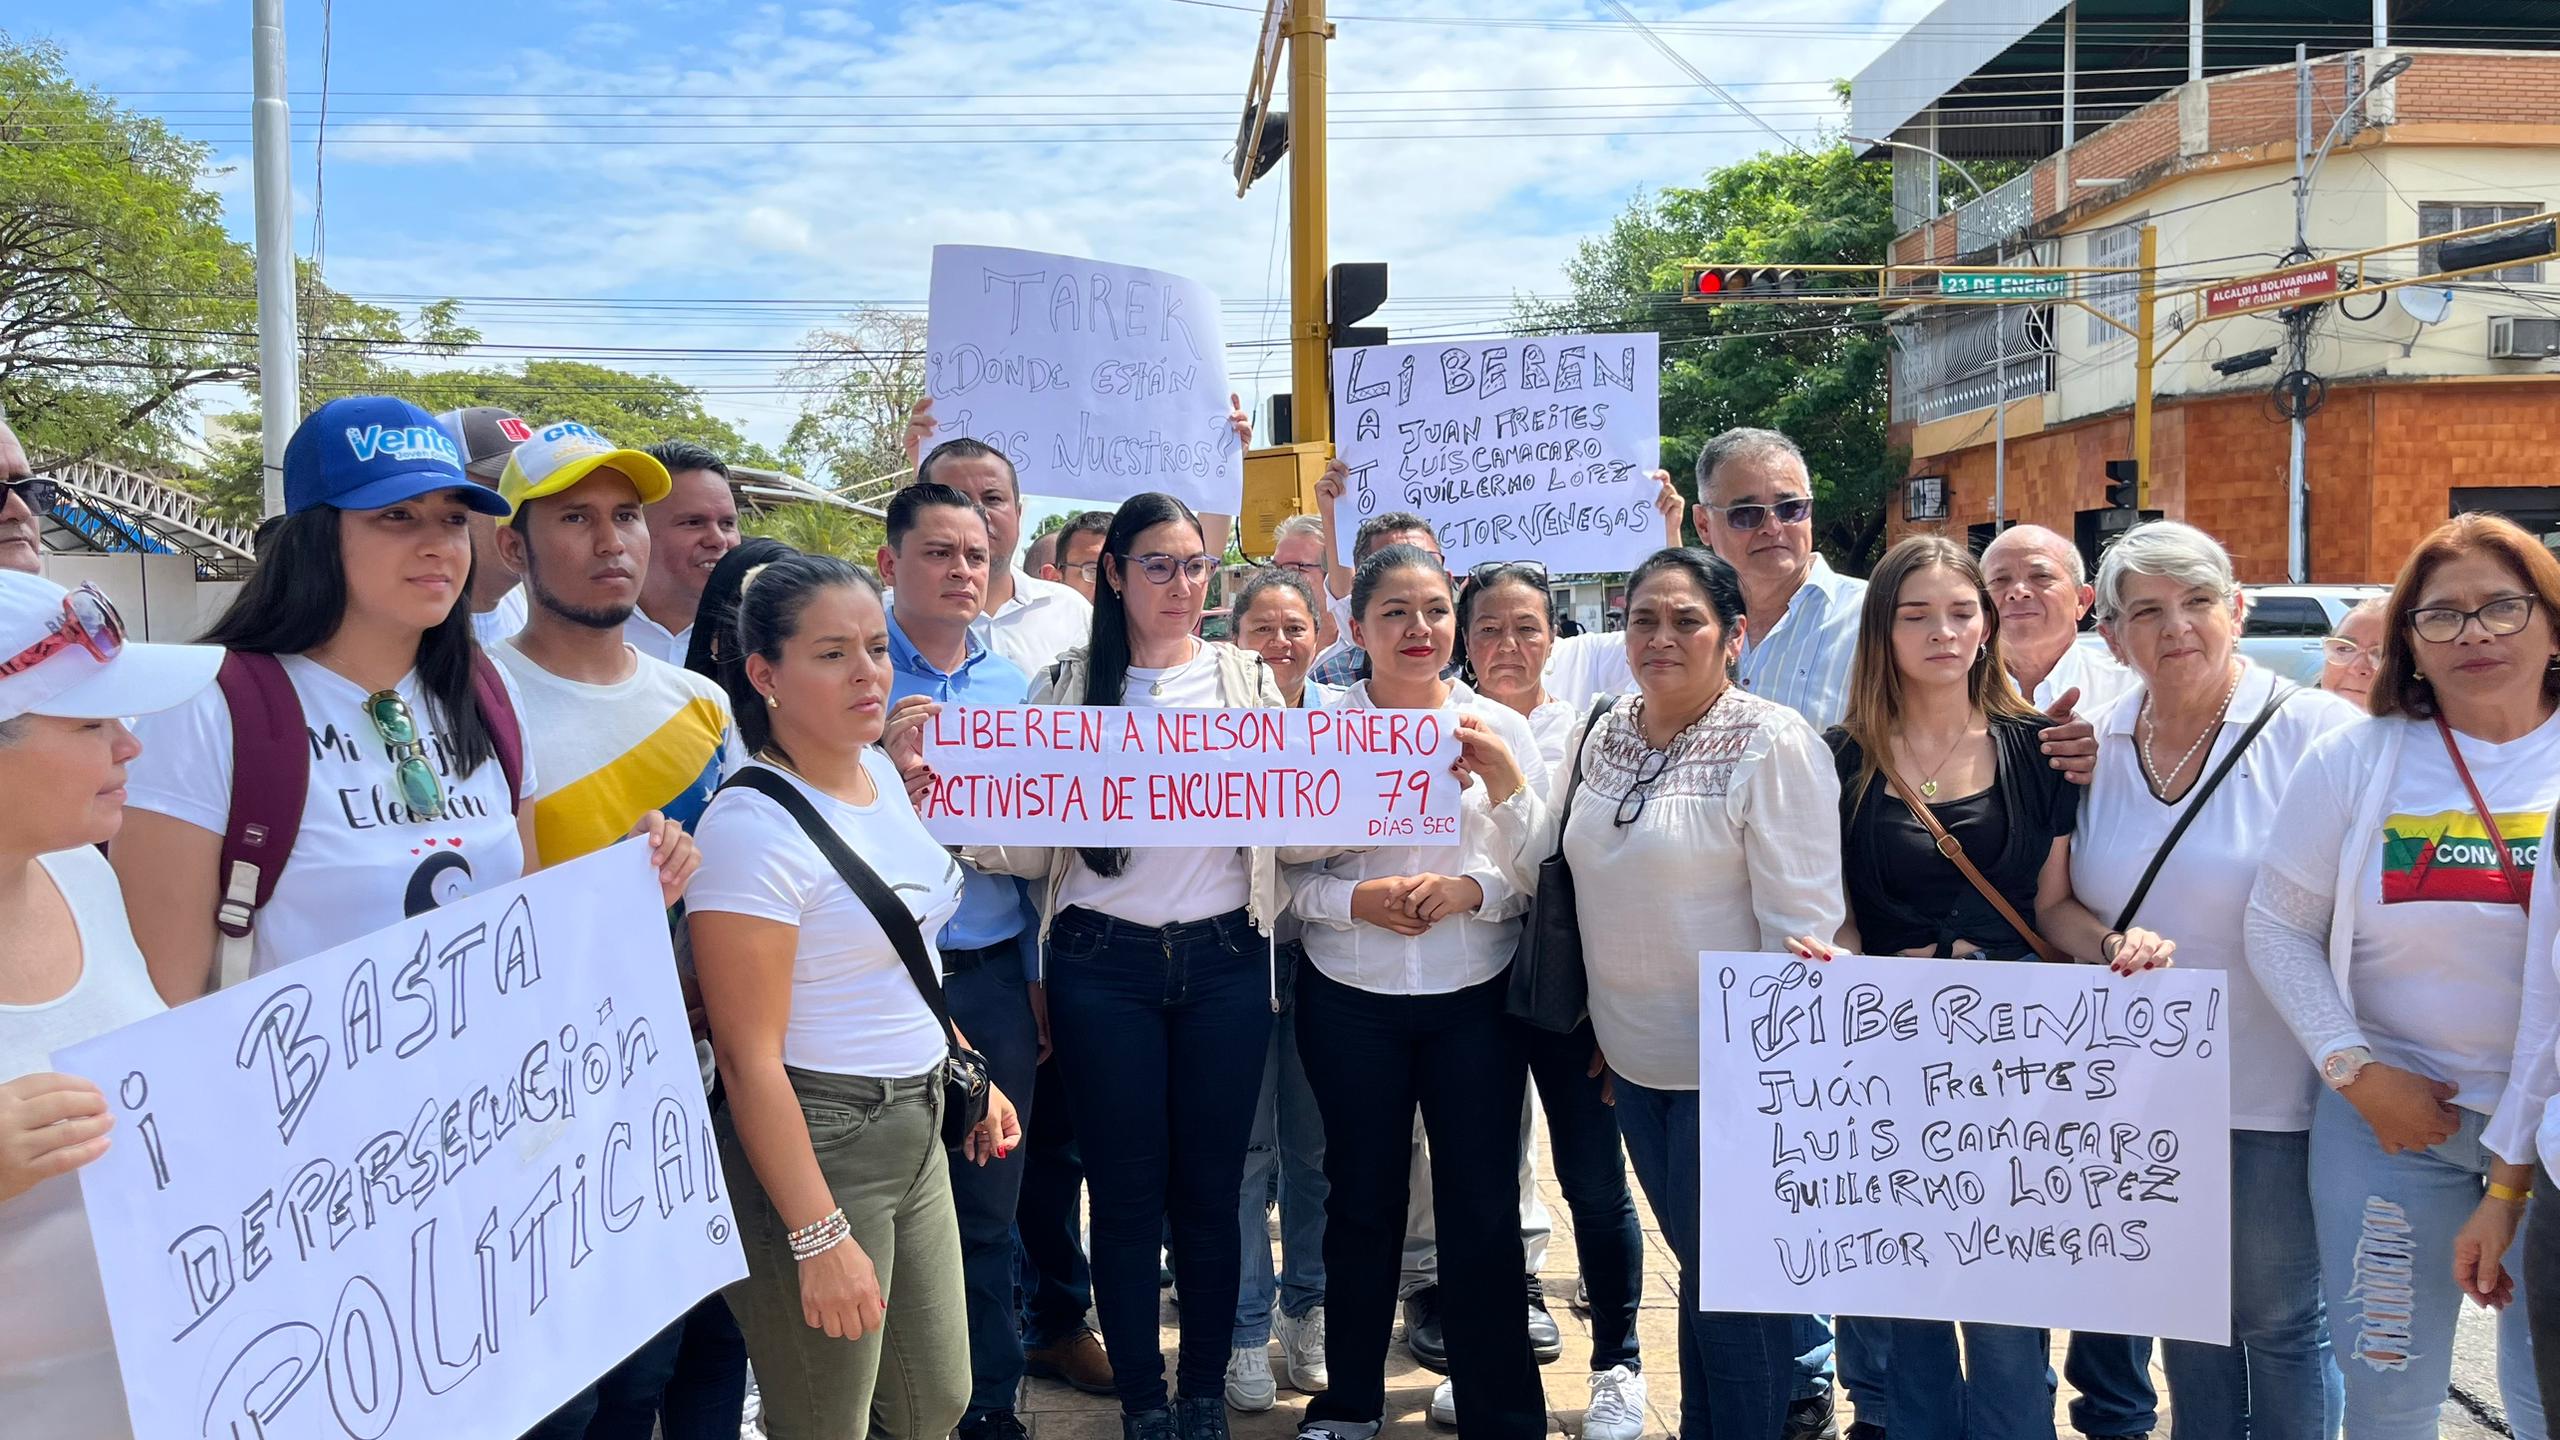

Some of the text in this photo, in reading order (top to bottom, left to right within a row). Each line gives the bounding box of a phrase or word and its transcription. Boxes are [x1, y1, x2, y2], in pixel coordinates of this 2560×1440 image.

[1947, 277, 2060, 294] 23 DE ENERO
[2260, 270, 2329, 293] BOLIVARIANA
[983, 267, 1202, 361] TAREK
[2238, 297, 2251, 308] DE
[345, 425, 459, 462] Vente
[1051, 411, 1234, 477] NUESTROS?
[1398, 416, 1481, 454] JUAN
[1472, 438, 1602, 474] CAMACARO
[1518, 501, 1651, 545] VENEGAS
[308, 724, 360, 762] Mi
[1122, 711, 1145, 753] A
[1158, 711, 1284, 752] NELSON
[1102, 775, 1134, 822] DE
[1148, 768, 1341, 821] ENCUENTRO
[1375, 770, 1430, 815] 79
[1424, 816, 1456, 835] SEC
